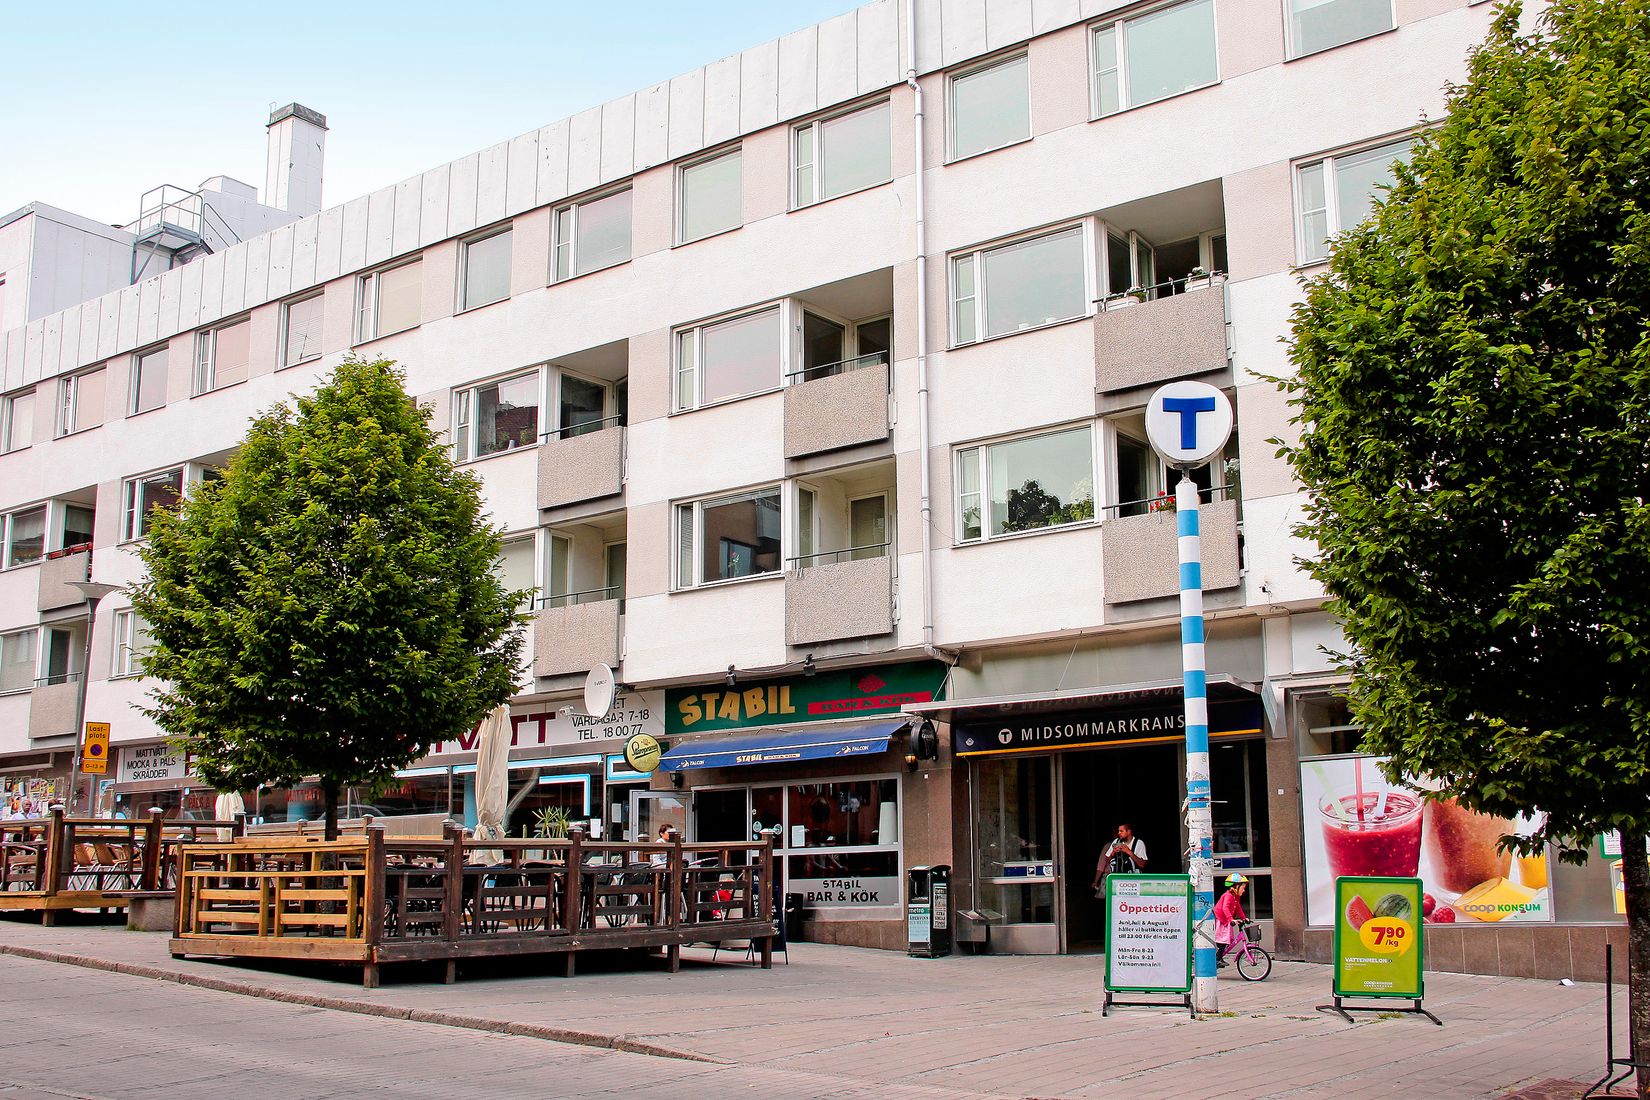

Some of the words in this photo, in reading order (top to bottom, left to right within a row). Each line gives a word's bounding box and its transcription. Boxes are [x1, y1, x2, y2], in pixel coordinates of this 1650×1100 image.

[1163, 396, 1215, 449] T
[679, 686, 795, 726] STABIL
[628, 709, 649, 721] 7-18
[1021, 715, 1185, 741] MIDSOMMARKRANS
[578, 729, 598, 740] TEL.
[736, 754, 763, 763] STABIL
[823, 880, 861, 889] STABIL
[807, 892, 832, 901] BAR
[838, 891, 846, 901] &
[851, 890, 879, 902] KÖK
[1497, 903, 1541, 912] KONSUM
